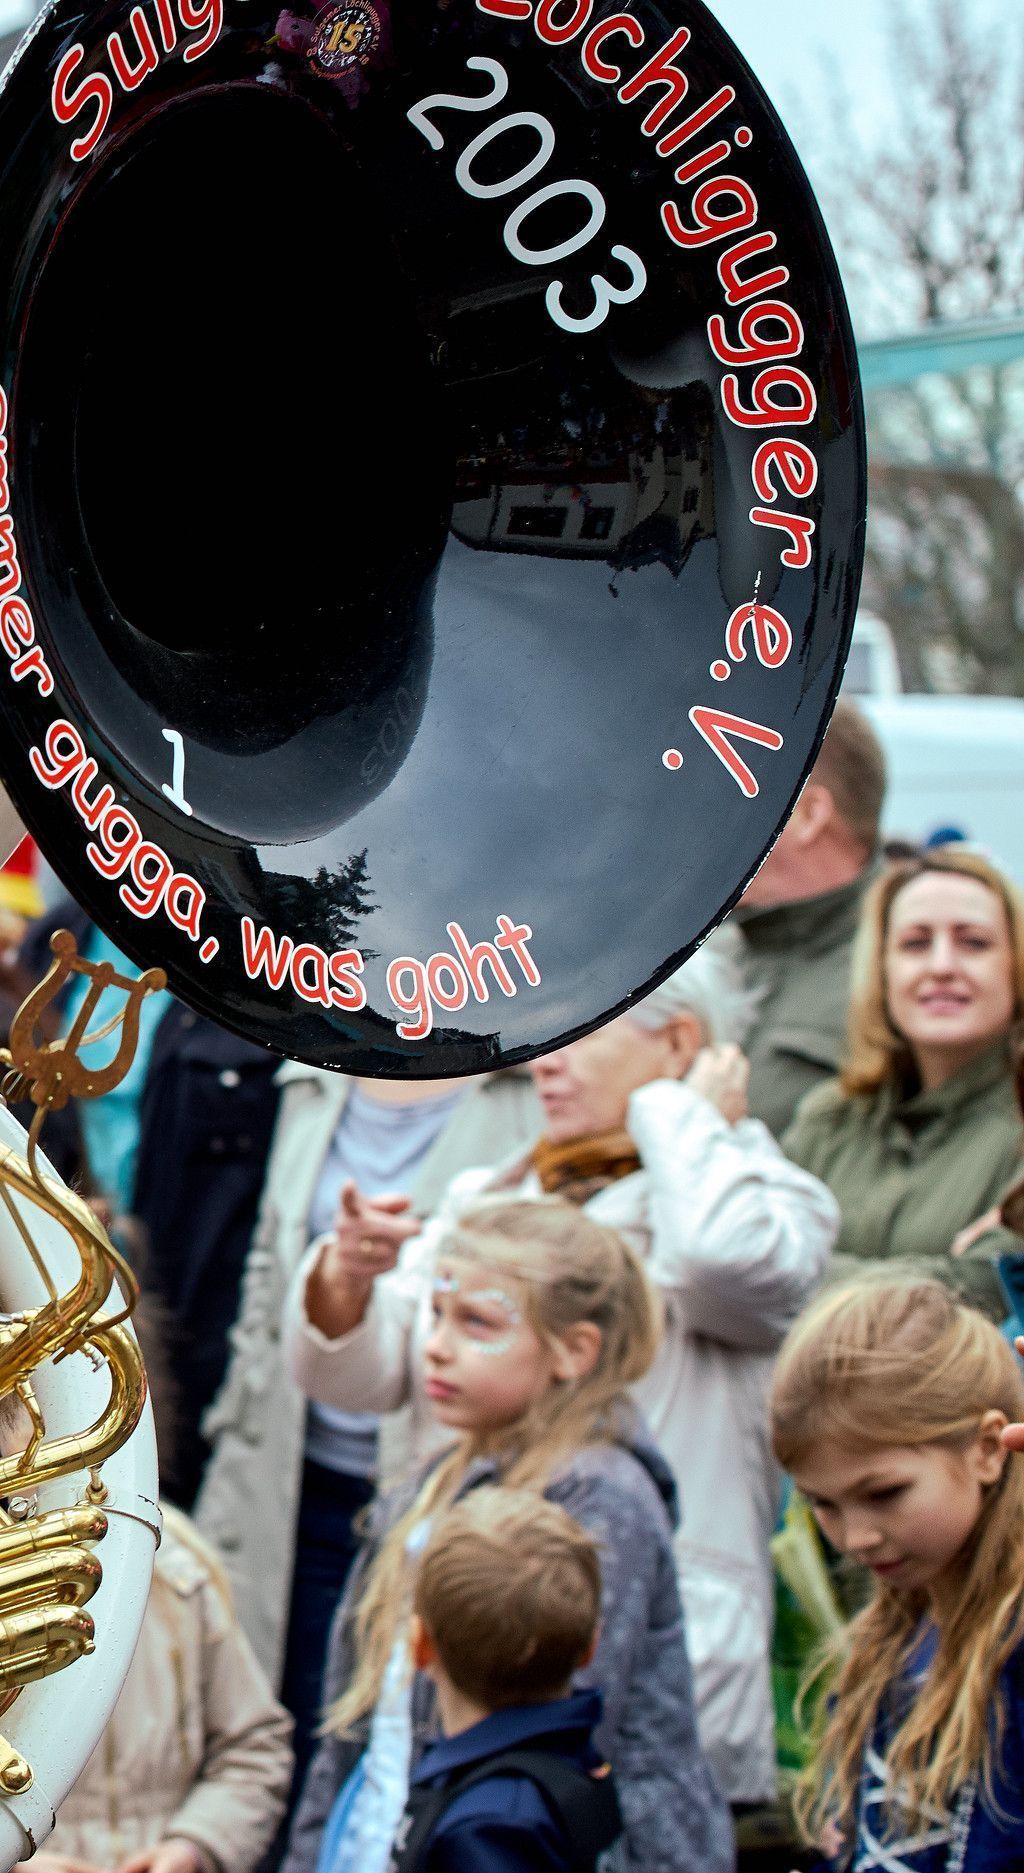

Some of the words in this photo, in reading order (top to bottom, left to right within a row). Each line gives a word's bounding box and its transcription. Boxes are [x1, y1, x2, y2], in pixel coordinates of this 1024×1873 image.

[325, 21, 366, 53] 15
[406, 56, 647, 333] 2003
[161, 728, 193, 817] 1
[29, 719, 220, 964] gugga,
[240, 916, 367, 1012] was
[386, 914, 542, 1040] goht
